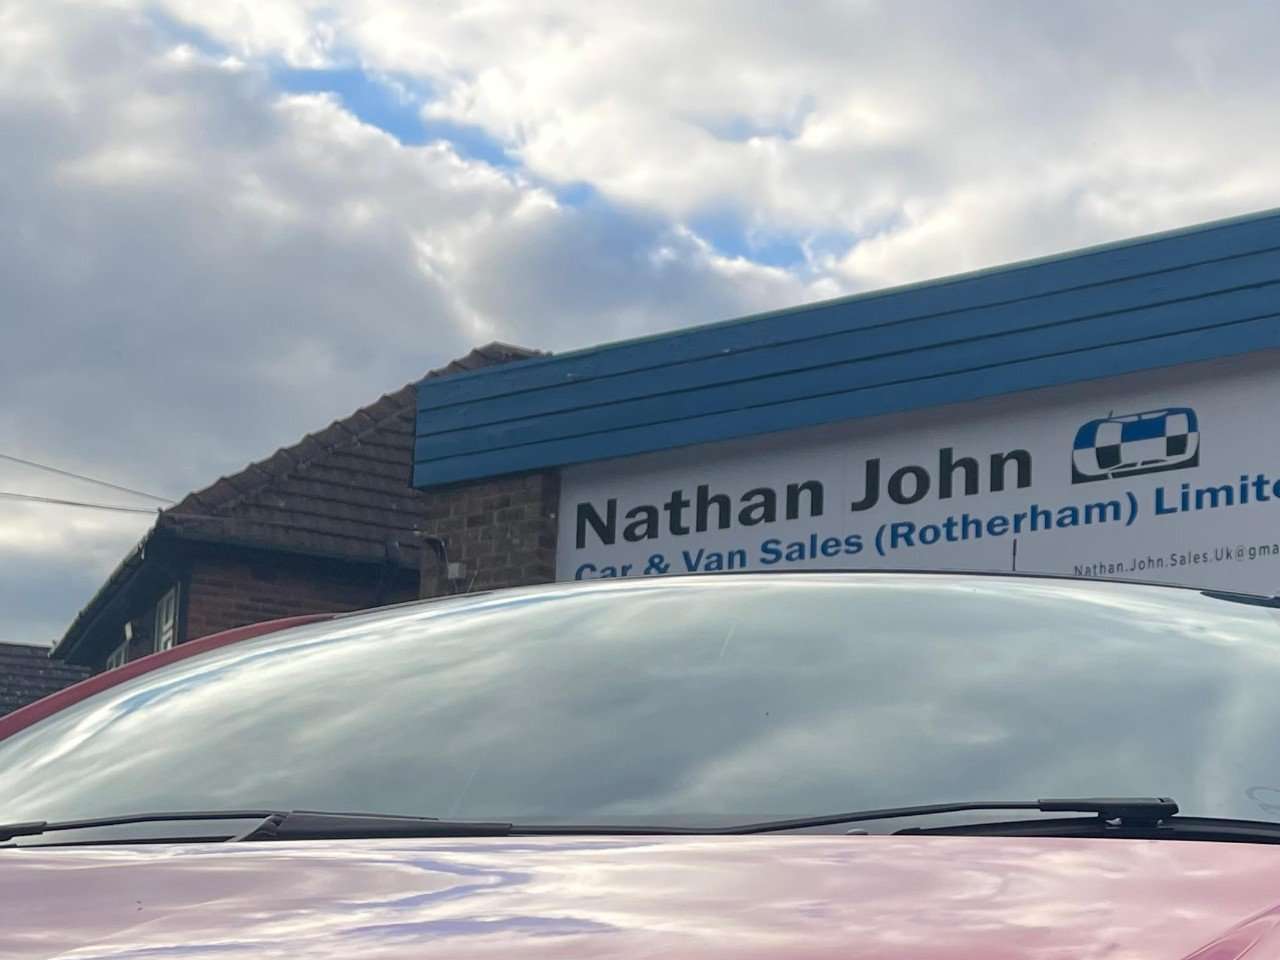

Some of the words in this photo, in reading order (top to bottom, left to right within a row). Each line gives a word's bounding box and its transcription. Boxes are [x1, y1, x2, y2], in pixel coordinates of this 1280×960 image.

[575, 479, 824, 549] Nathan
[851, 447, 1032, 512] John
[575, 563, 632, 581] Car
[643, 553, 670, 575] &
[682, 548, 747, 572] Van
[759, 533, 863, 565] Sales
[875, 492, 1138, 556] (Rotherham)
